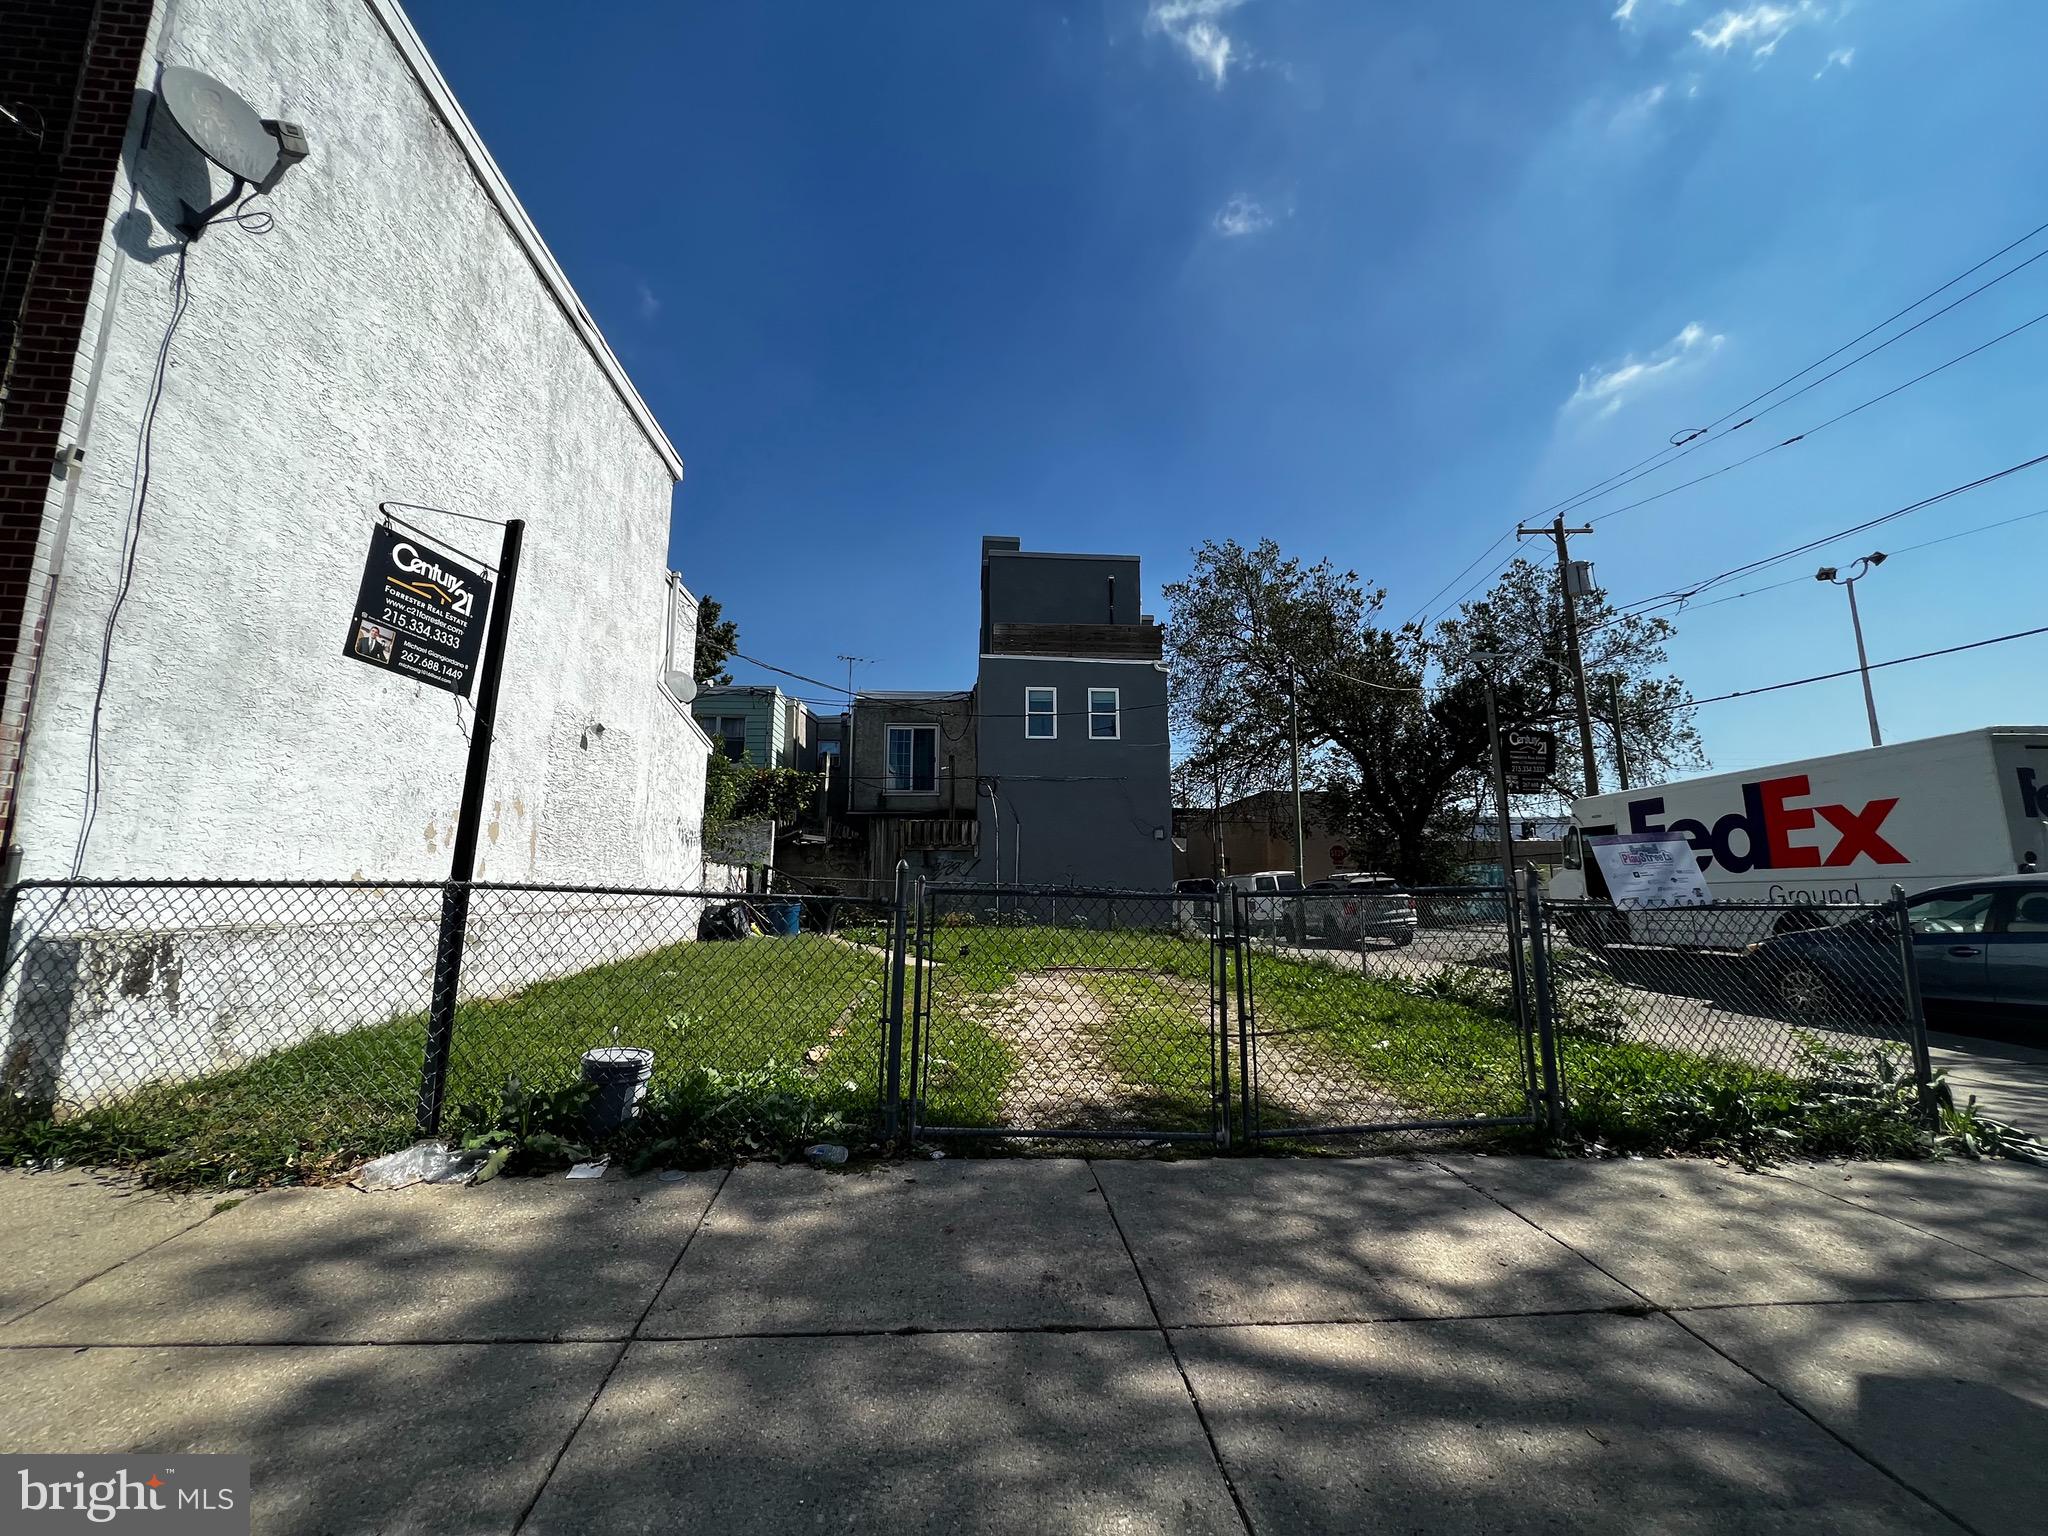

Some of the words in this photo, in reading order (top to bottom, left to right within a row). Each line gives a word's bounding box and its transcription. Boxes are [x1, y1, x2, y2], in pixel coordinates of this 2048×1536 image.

[392, 543, 464, 592] Century
[451, 590, 473, 617] 21
[381, 607, 460, 649] 215.334.3333
[385, 597, 464, 636] www.c21forrester.com
[400, 649, 463, 680] 267.688.1449
[403, 640, 427, 654] Michael
[1509, 732, 1541, 746] Century
[1537, 741, 1547, 754] 21
[1628, 774, 1911, 874] FedEx
[1768, 882, 1861, 905] Ground
